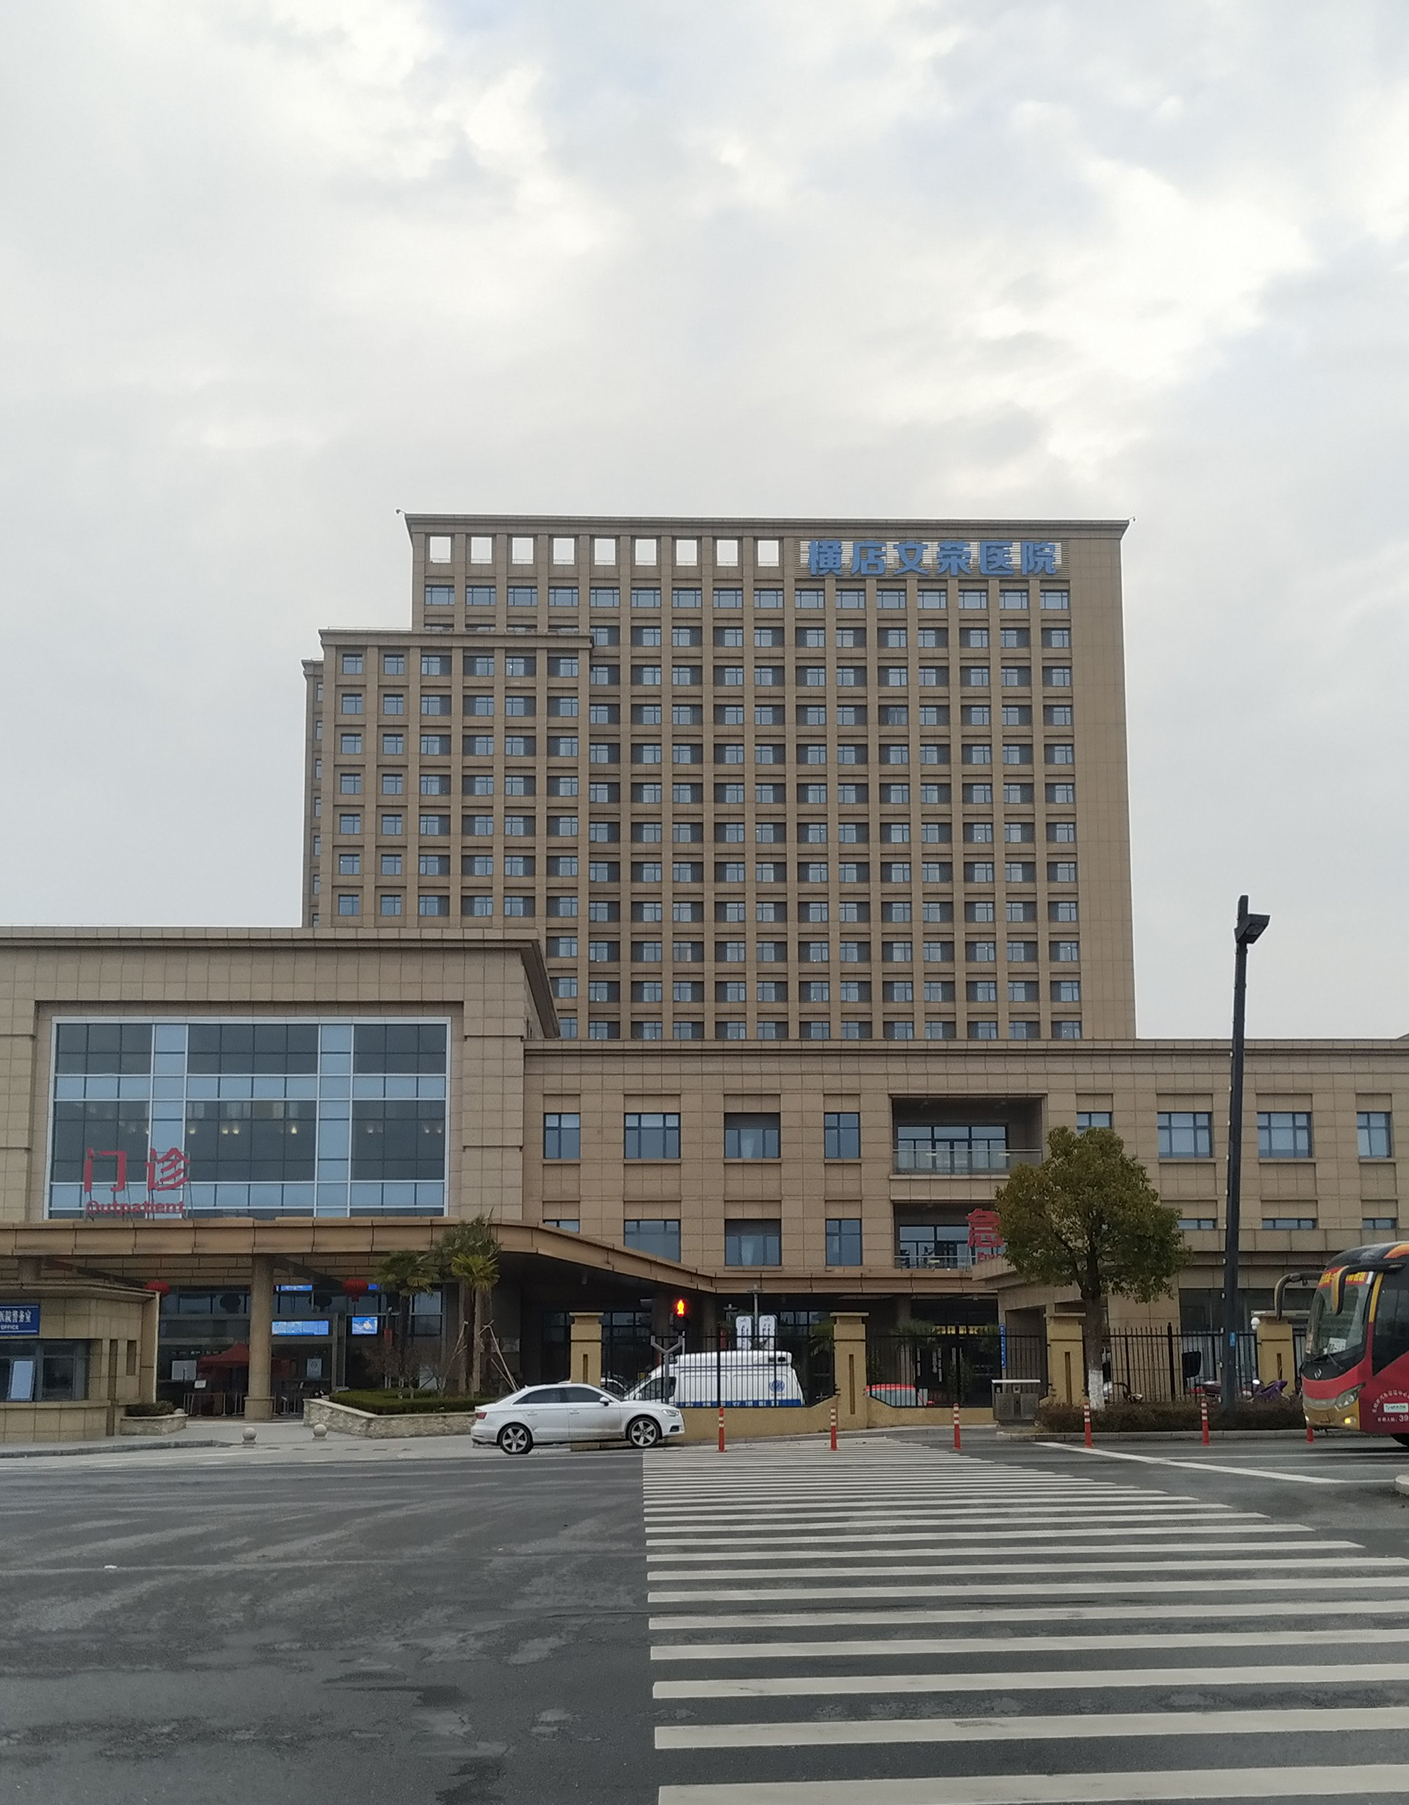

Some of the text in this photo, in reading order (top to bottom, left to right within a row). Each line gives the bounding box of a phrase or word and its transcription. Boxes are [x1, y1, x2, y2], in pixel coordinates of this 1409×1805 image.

[807, 539, 1058, 576] 横店文荣医院
[84, 1147, 191, 1193] 门诊
[86, 1200, 184, 1216] Outpatient
[965, 1208, 1004, 1248] 急
